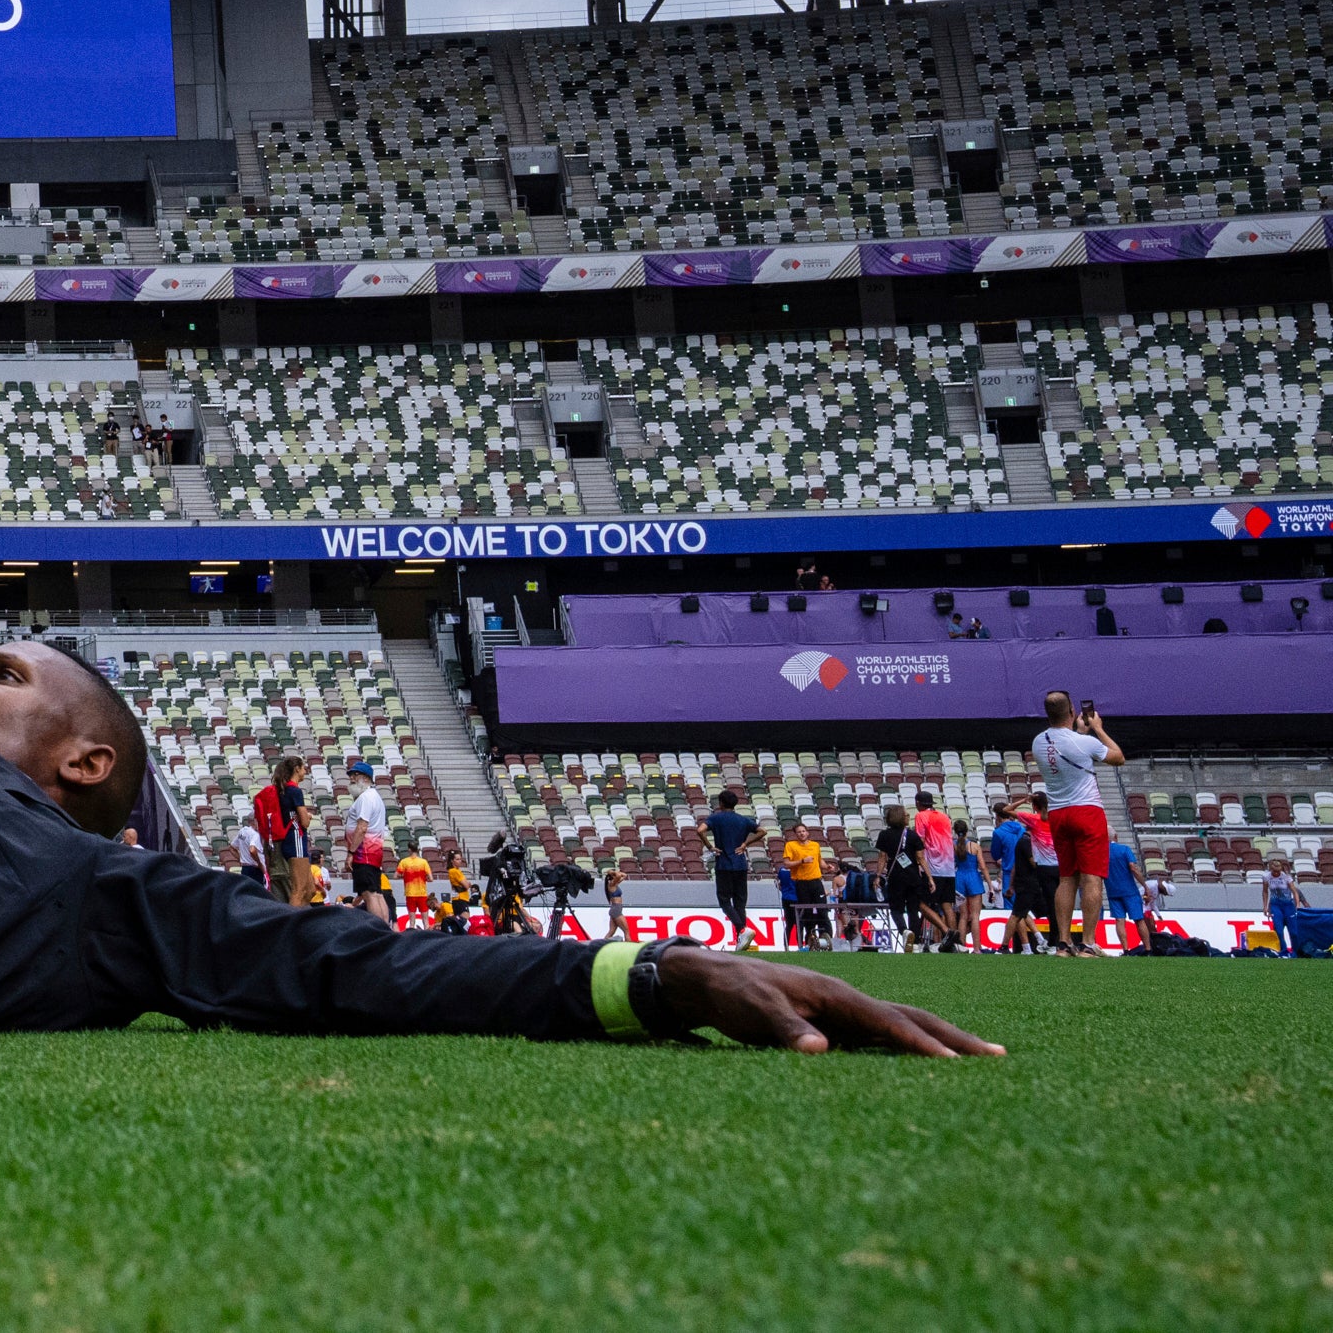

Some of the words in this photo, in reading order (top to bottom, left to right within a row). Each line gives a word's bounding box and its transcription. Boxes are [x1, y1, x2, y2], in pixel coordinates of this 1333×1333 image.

[981, 377, 1001, 386] 220
[1016, 375, 1036, 385] 219
[549, 392, 567, 402] 221
[581, 392, 600, 401] 220
[144, 400, 162, 409] 222
[176, 400, 193, 409] 221
[1277, 505, 1310, 514] WORLD
[321, 525, 508, 557] WELCOME
[515, 524, 567, 555] TO
[575, 521, 707, 554] TOKYO
[856, 655, 893, 665] WORLD
[895, 654, 949, 664] ATHLETICS
[856, 664, 950, 675] CHAMPIONSHIPS
